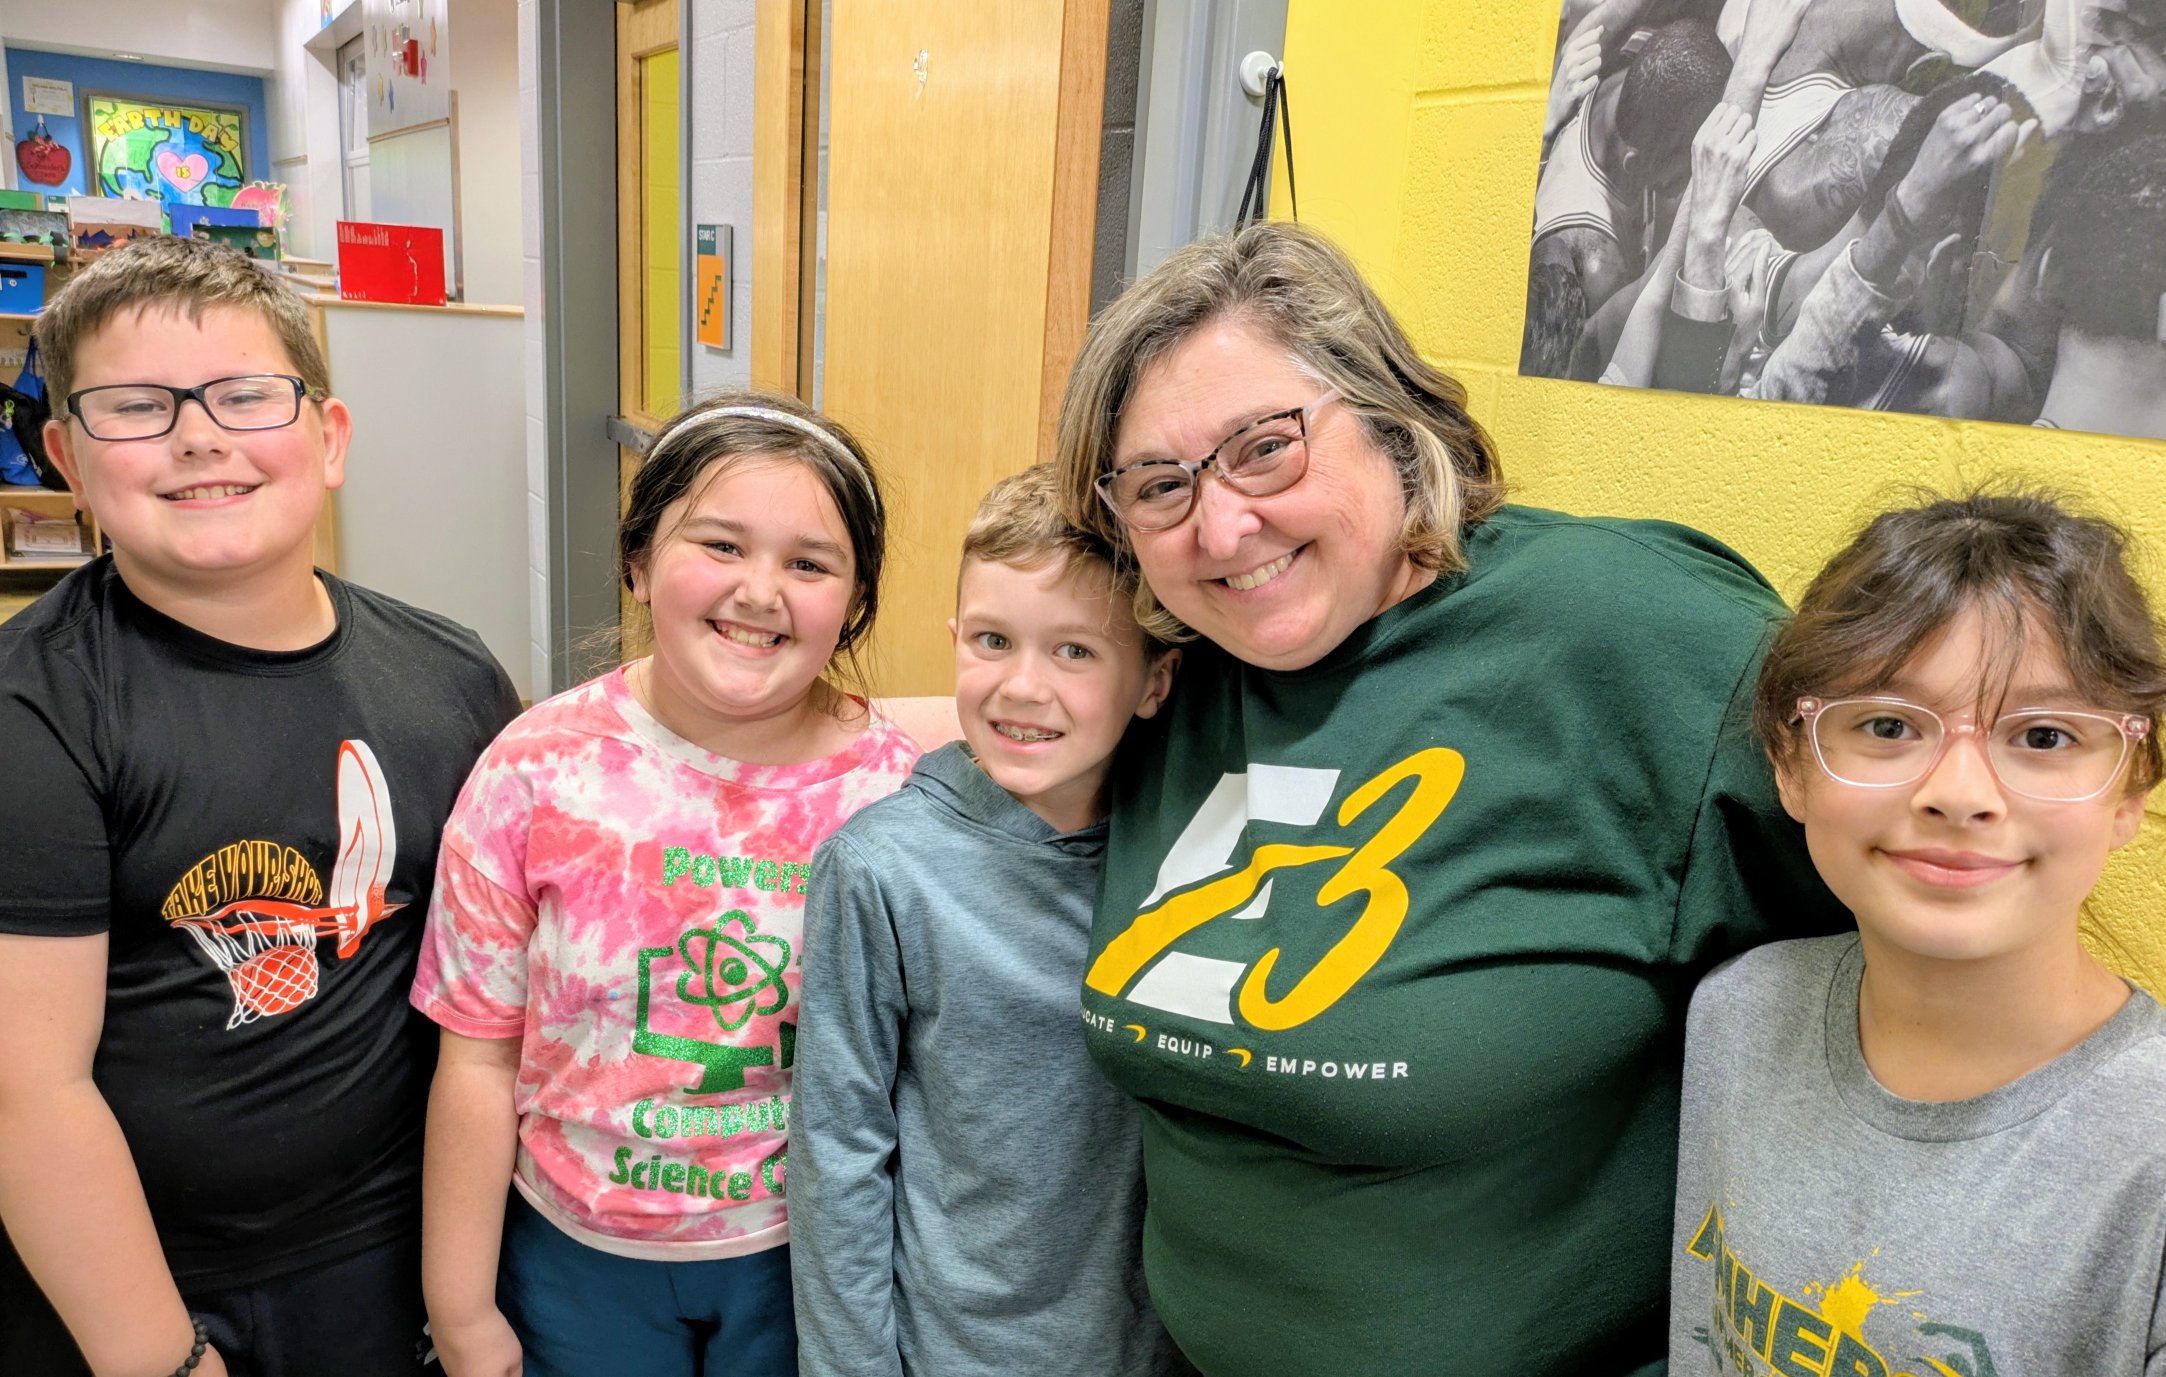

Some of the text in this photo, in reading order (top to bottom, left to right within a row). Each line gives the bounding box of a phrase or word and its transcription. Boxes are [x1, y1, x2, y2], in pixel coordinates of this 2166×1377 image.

[98, 109, 239, 151] EARTH DAY
[176, 166, 191, 178] IS
[161, 840, 323, 920] TAKE YOUR SHOT
[1157, 1033, 1213, 1059] EQUIP
[1266, 1055, 1409, 1080] EMPOWER
[632, 1095, 791, 1140] Comput
[609, 1145, 788, 1201] Science C
